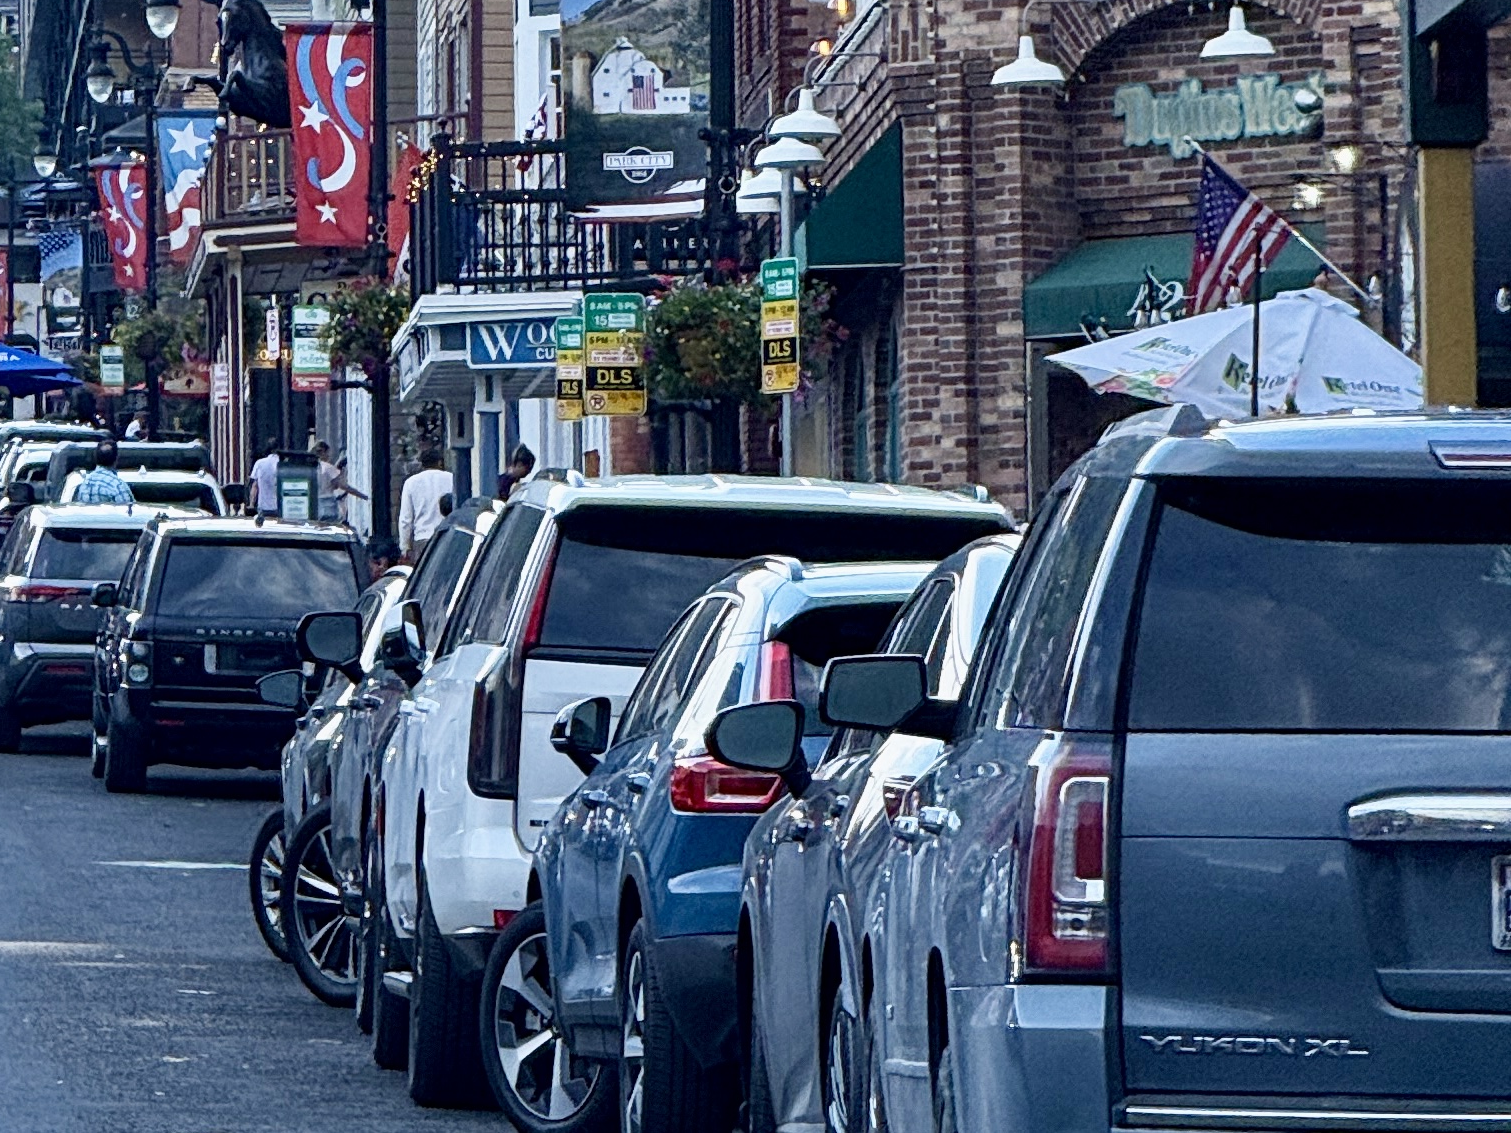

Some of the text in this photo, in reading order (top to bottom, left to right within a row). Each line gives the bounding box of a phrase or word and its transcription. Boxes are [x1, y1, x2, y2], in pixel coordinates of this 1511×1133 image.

[609, 156, 667, 166] PARK CITY
[594, 315, 608, 327] 15
[769, 342, 791, 357] DLS
[597, 369, 632, 384] DLS
[561, 382, 579, 395] DLS
[1368, 380, 1400, 394] One
[1140, 1035, 1370, 1057] YUKON XL
